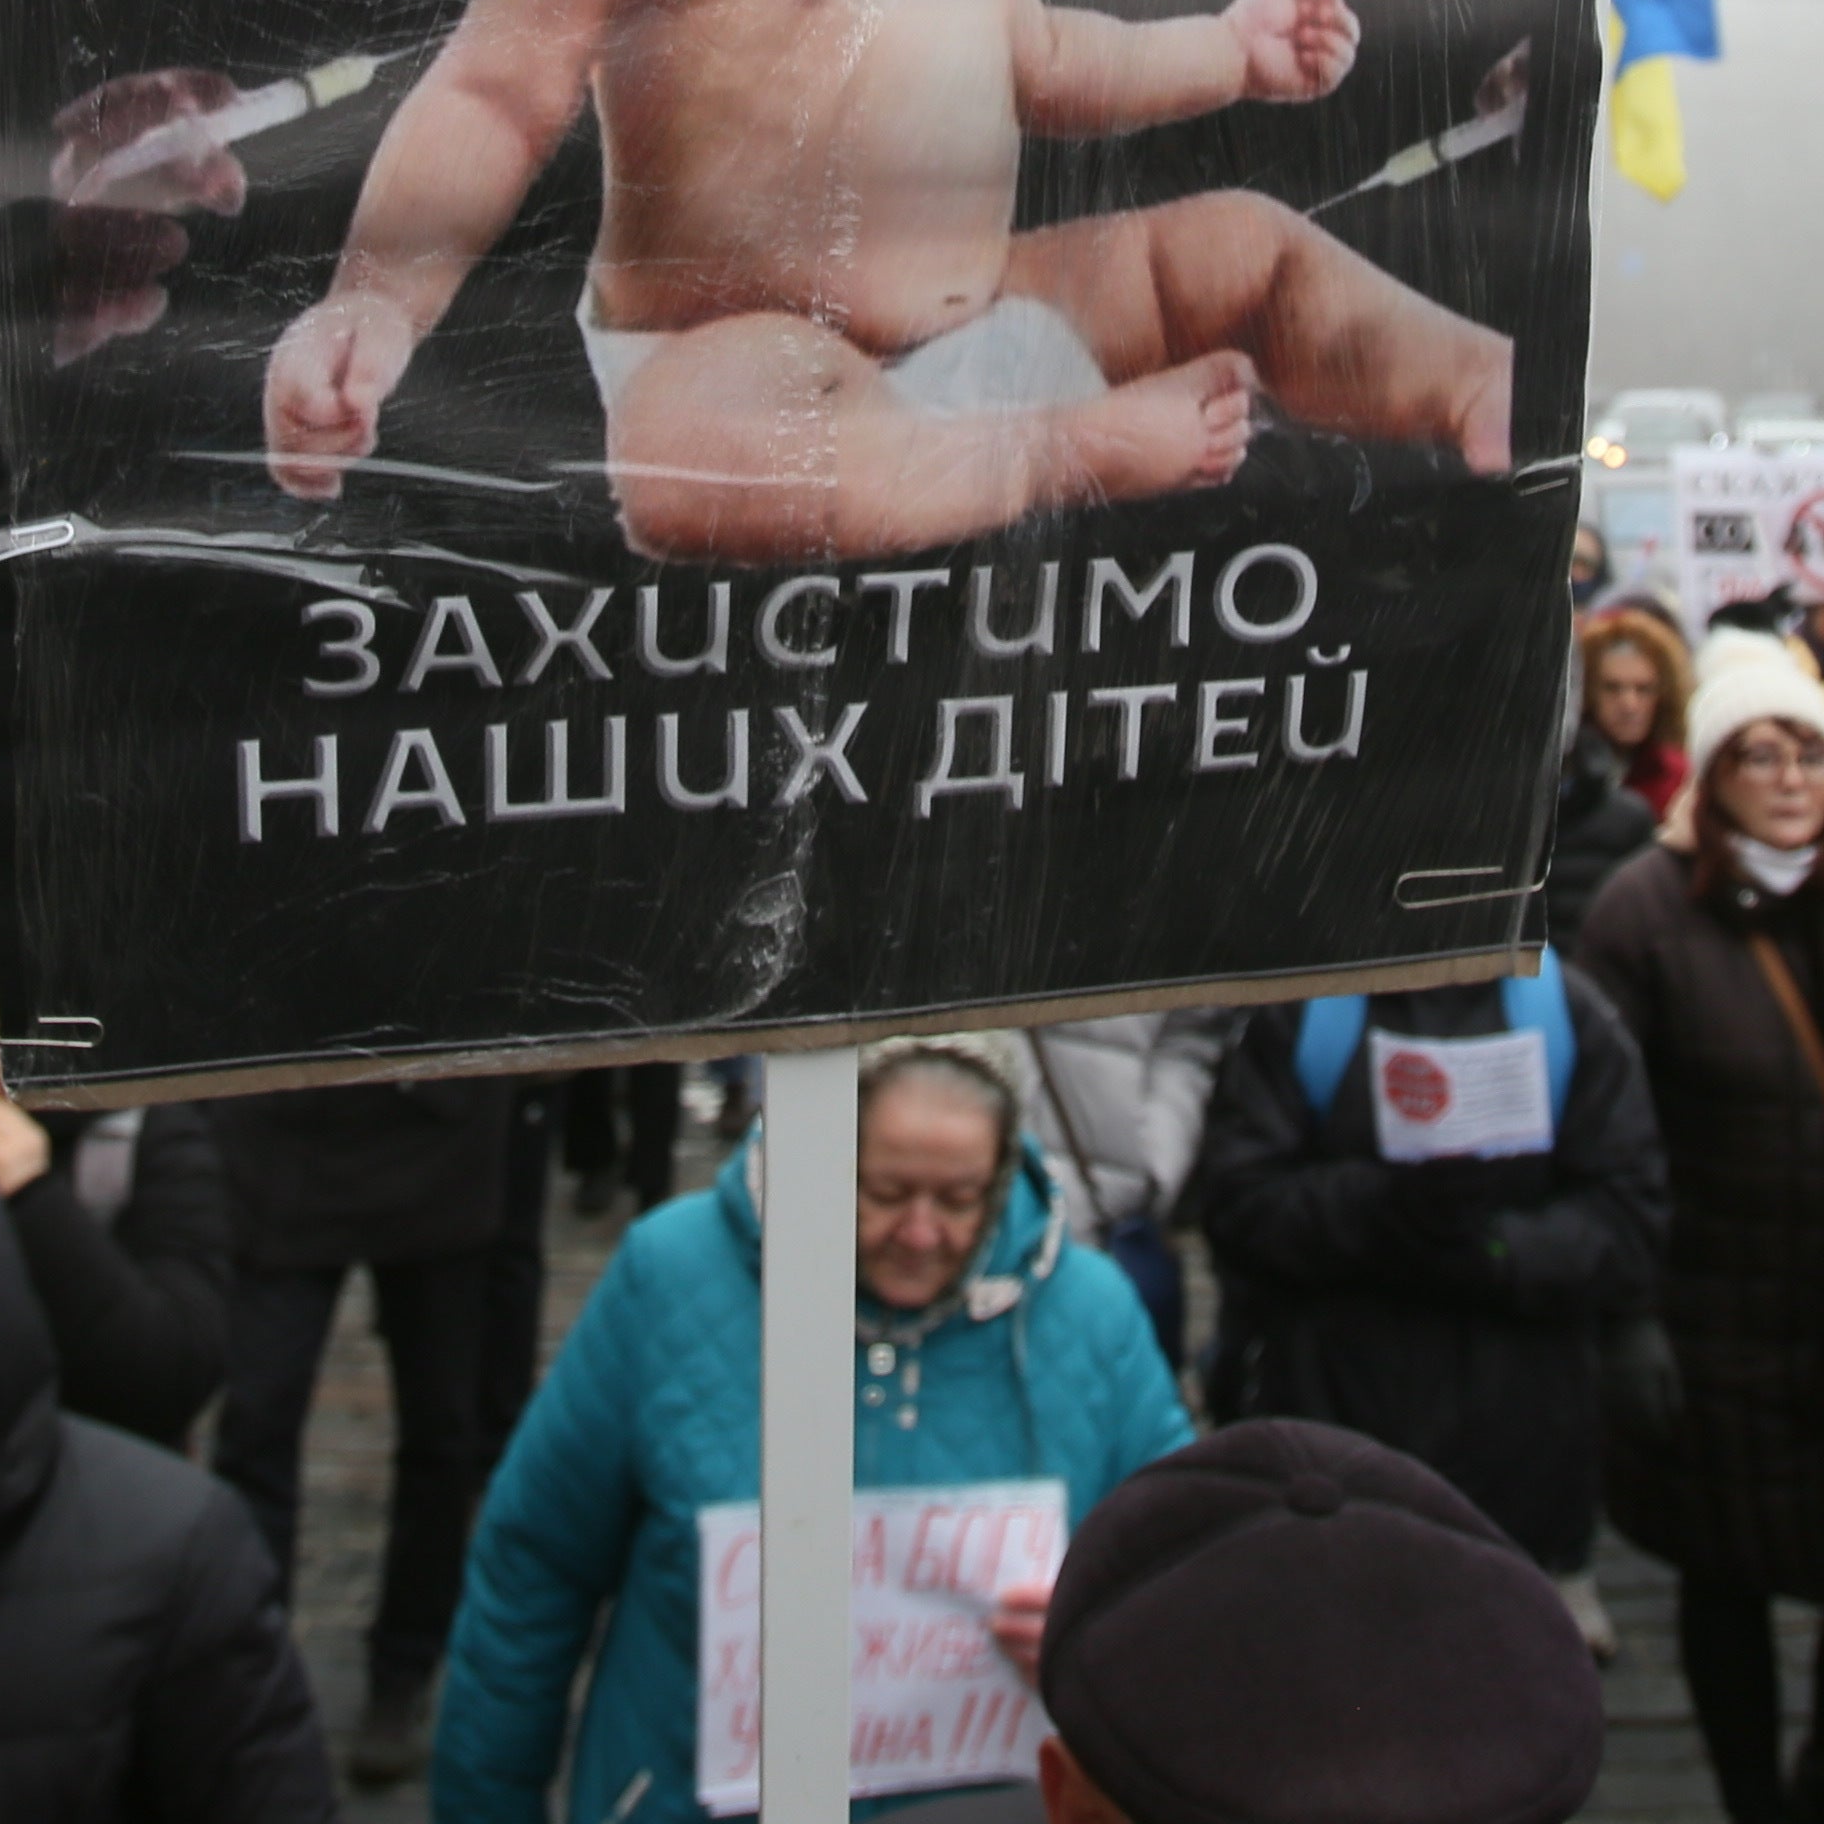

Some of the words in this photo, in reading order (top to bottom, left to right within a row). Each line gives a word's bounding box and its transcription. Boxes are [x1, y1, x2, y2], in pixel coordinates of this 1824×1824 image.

[300, 541, 1322, 699] ЗАХИСТИМО
[234, 695, 869, 843] НАШИХ
[912, 644, 1372, 823] ДІТЕЙ
